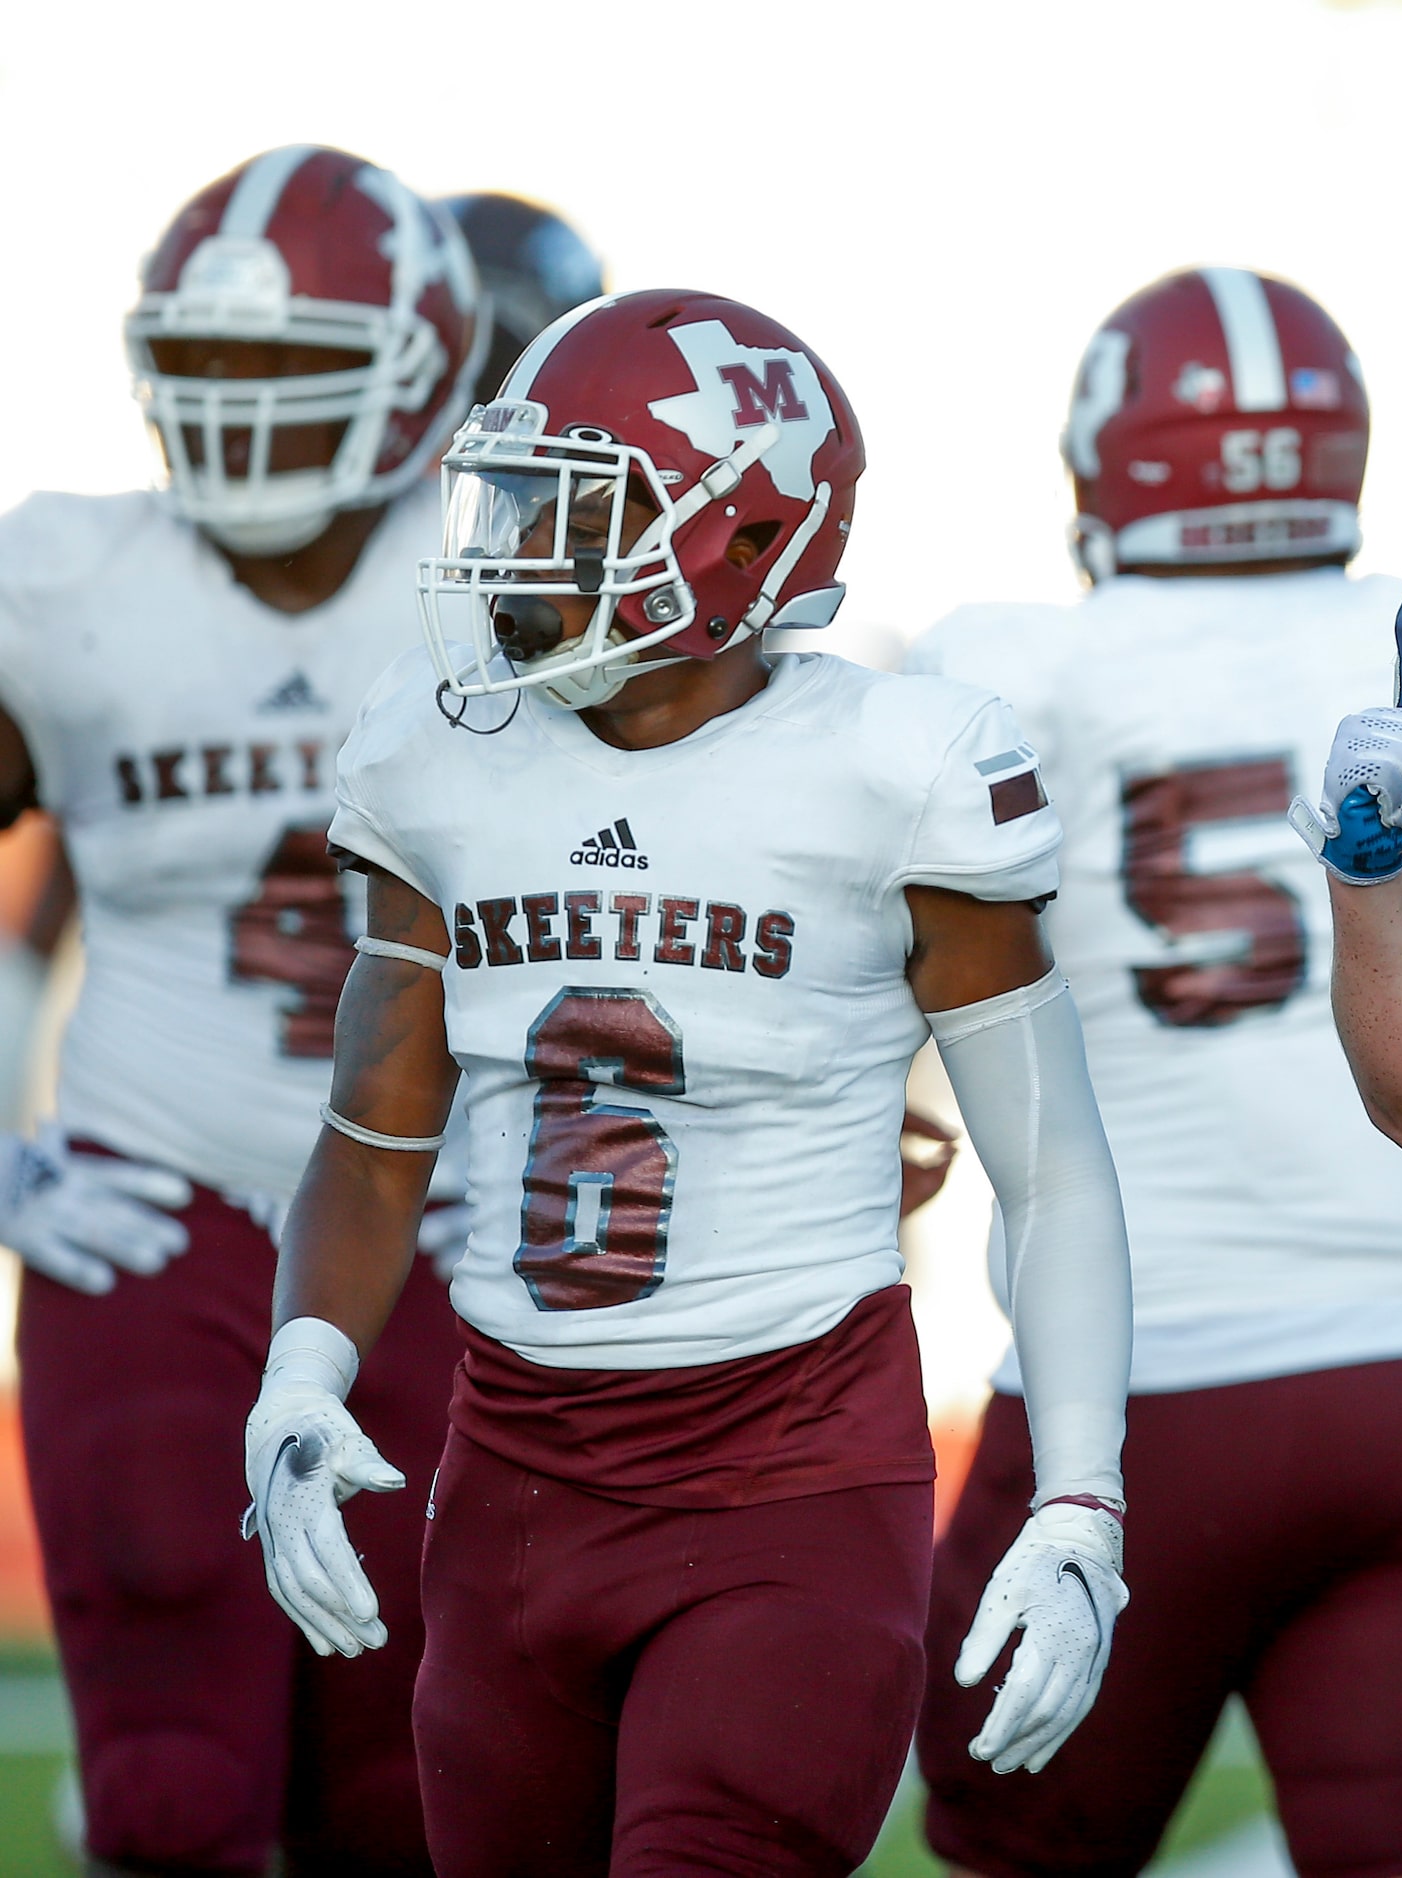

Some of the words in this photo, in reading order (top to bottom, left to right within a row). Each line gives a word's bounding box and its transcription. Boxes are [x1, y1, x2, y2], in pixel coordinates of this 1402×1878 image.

[716, 358, 810, 429] M
[1221, 427, 1302, 493] 56
[115, 736, 326, 808] SKEET
[569, 846, 649, 870] adidas
[453, 889, 796, 980] SKEETERS
[512, 984, 687, 1312] 6
